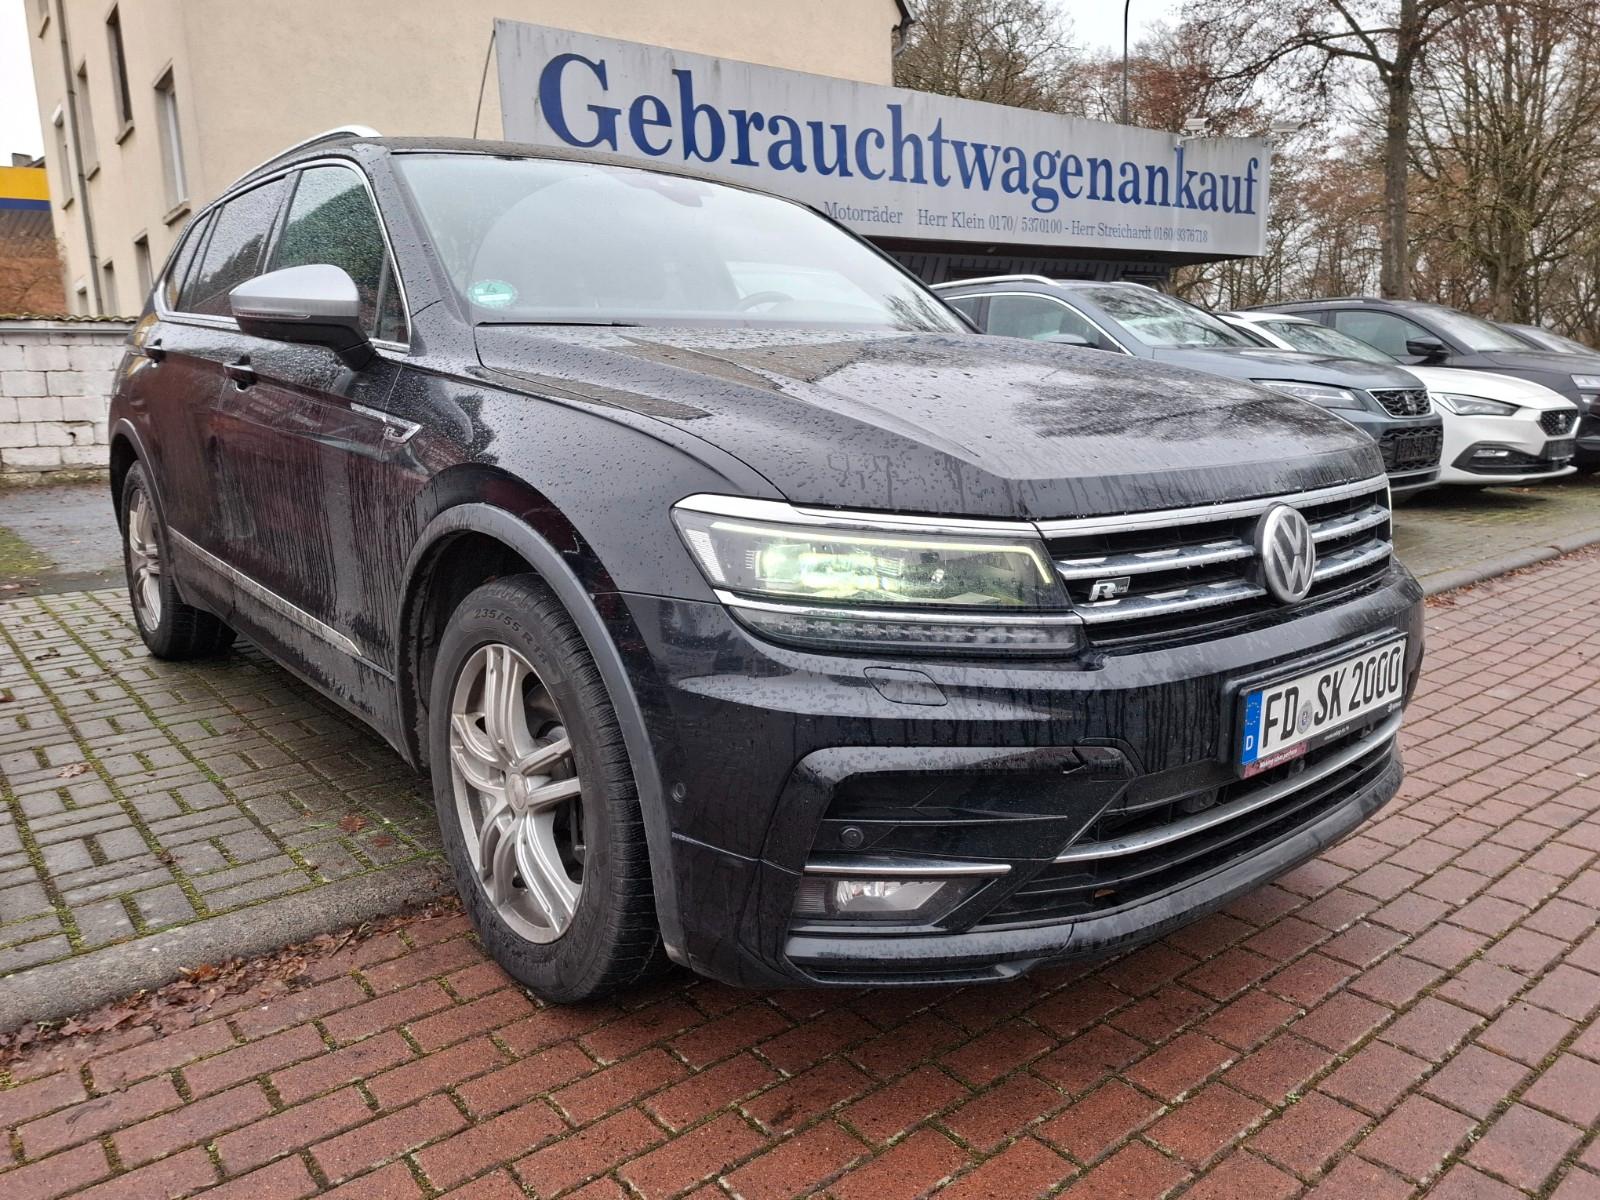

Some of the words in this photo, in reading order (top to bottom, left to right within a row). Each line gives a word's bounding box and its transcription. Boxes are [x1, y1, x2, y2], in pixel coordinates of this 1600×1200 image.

[540, 53, 1259, 215] Gebrauchtwagenankauf
[823, 201, 903, 224] Motorräder
[917, 208, 948, 228] Herr
[951, 211, 985, 230] Klein
[988, 214, 1019, 235] 0170/
[1021, 216, 1062, 234] 5370100
[1071, 220, 1096, 236] Herr
[1097, 222, 1152, 240] Streichardt
[1262, 686, 1299, 749] FD
[1314, 667, 1347, 726] SK
[1348, 646, 1401, 712] 2000
[1245, 735, 1254, 751] D
